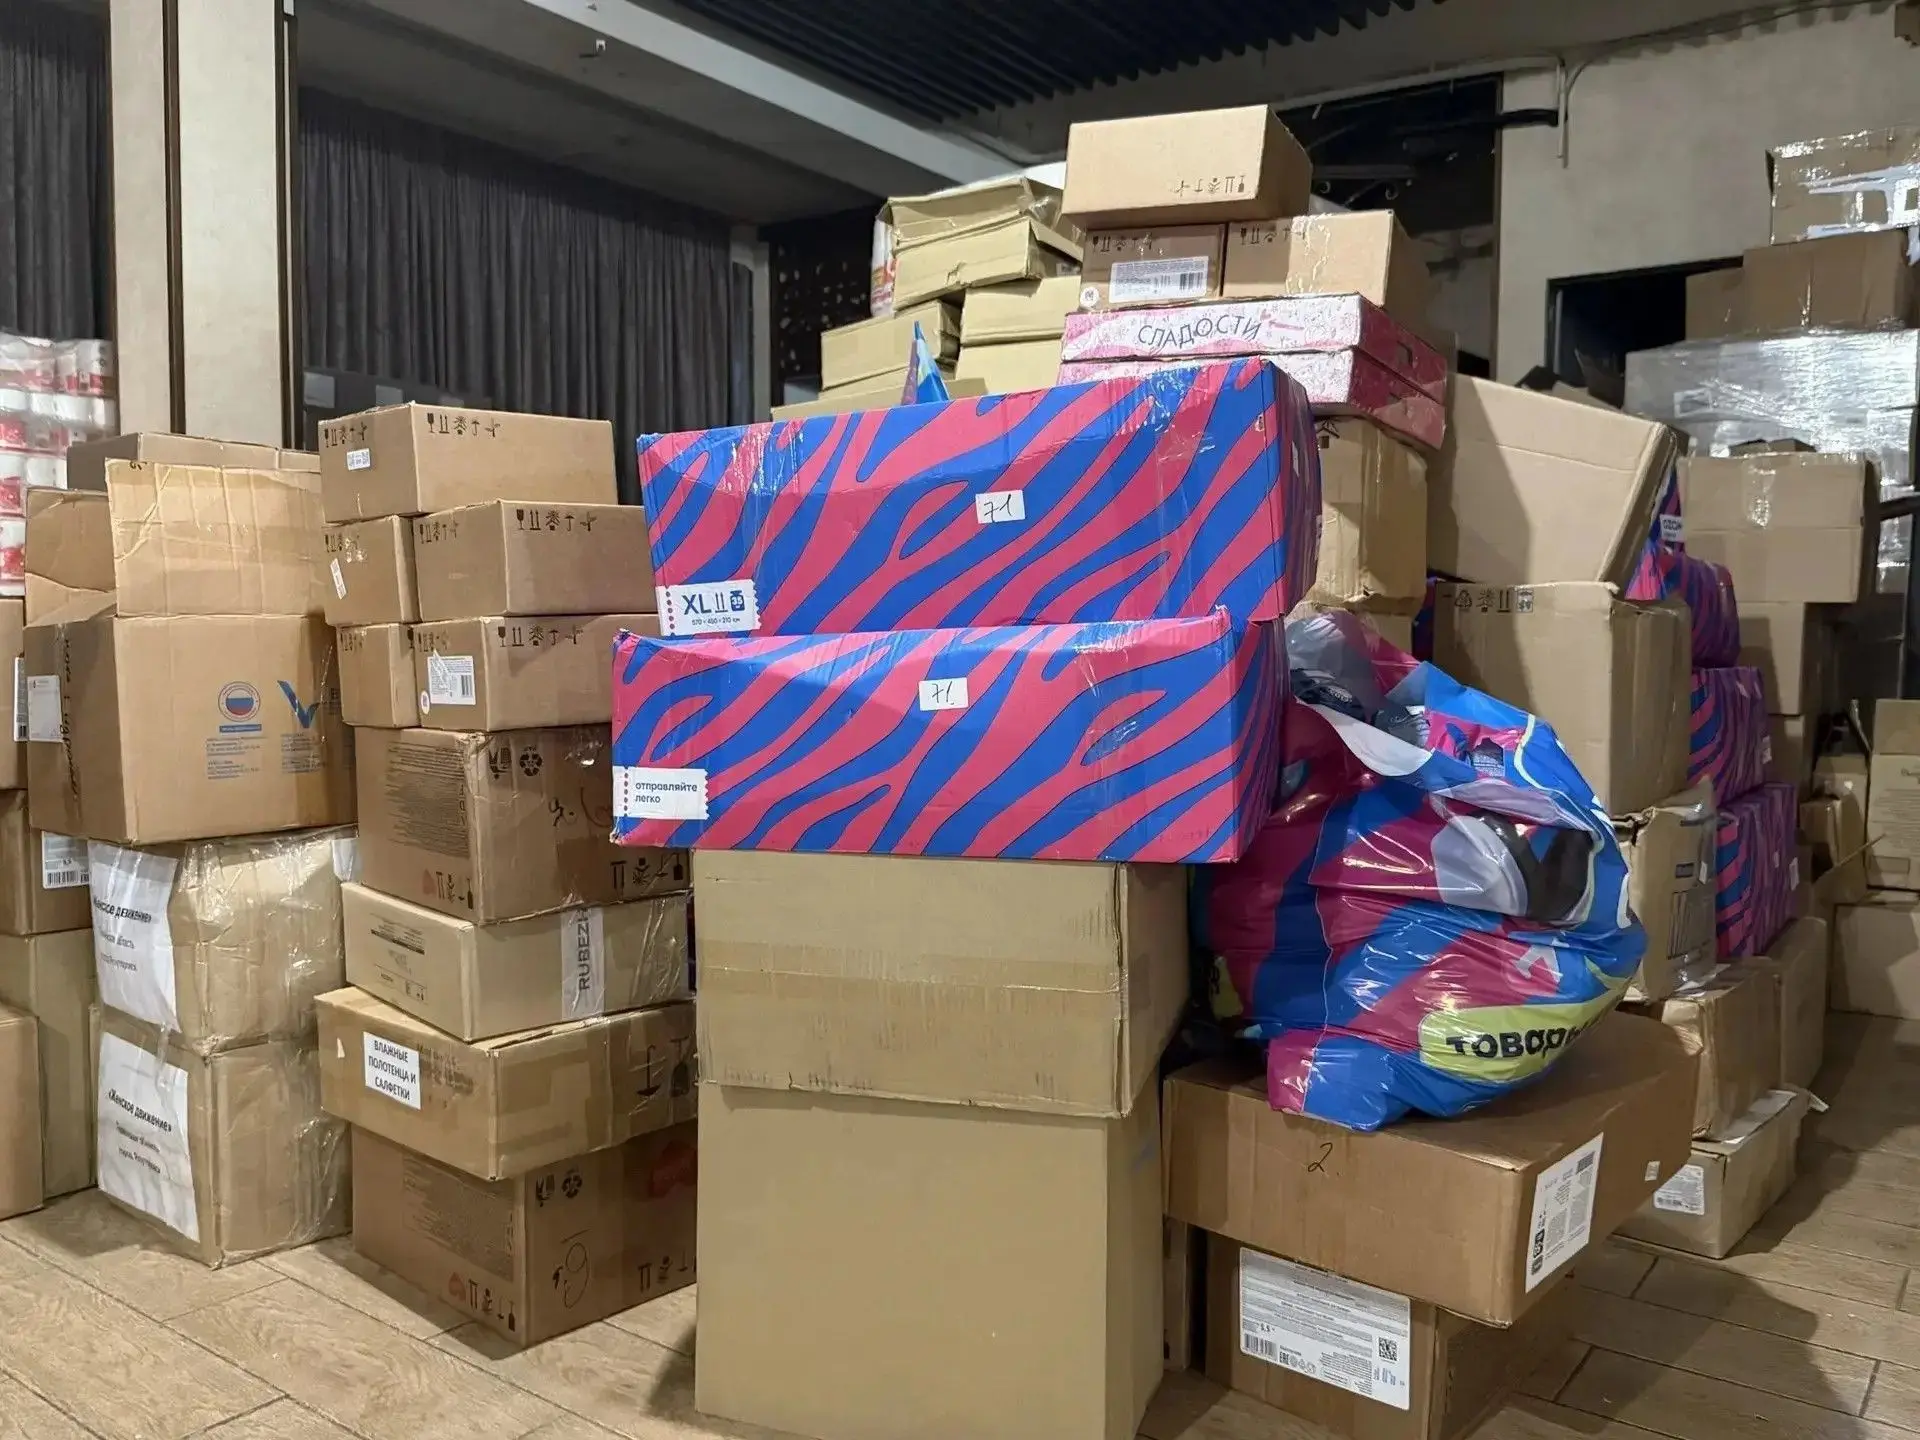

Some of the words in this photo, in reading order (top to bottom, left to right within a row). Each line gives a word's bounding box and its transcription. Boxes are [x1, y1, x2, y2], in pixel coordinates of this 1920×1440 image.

[1137, 314, 1262, 351] СЛАДОСТИ
[983, 492, 1014, 524] 71
[681, 593, 712, 616] XL
[635, 781, 698, 793] отправляйте
[635, 794, 661, 804] легко
[374, 1039, 409, 1063] ВЛАЖНЫЕ
[368, 1055, 410, 1083] ПОЛОТЕНЦА
[410, 1074, 416, 1084] И
[374, 1076, 411, 1101] САЛФЕТКИ
